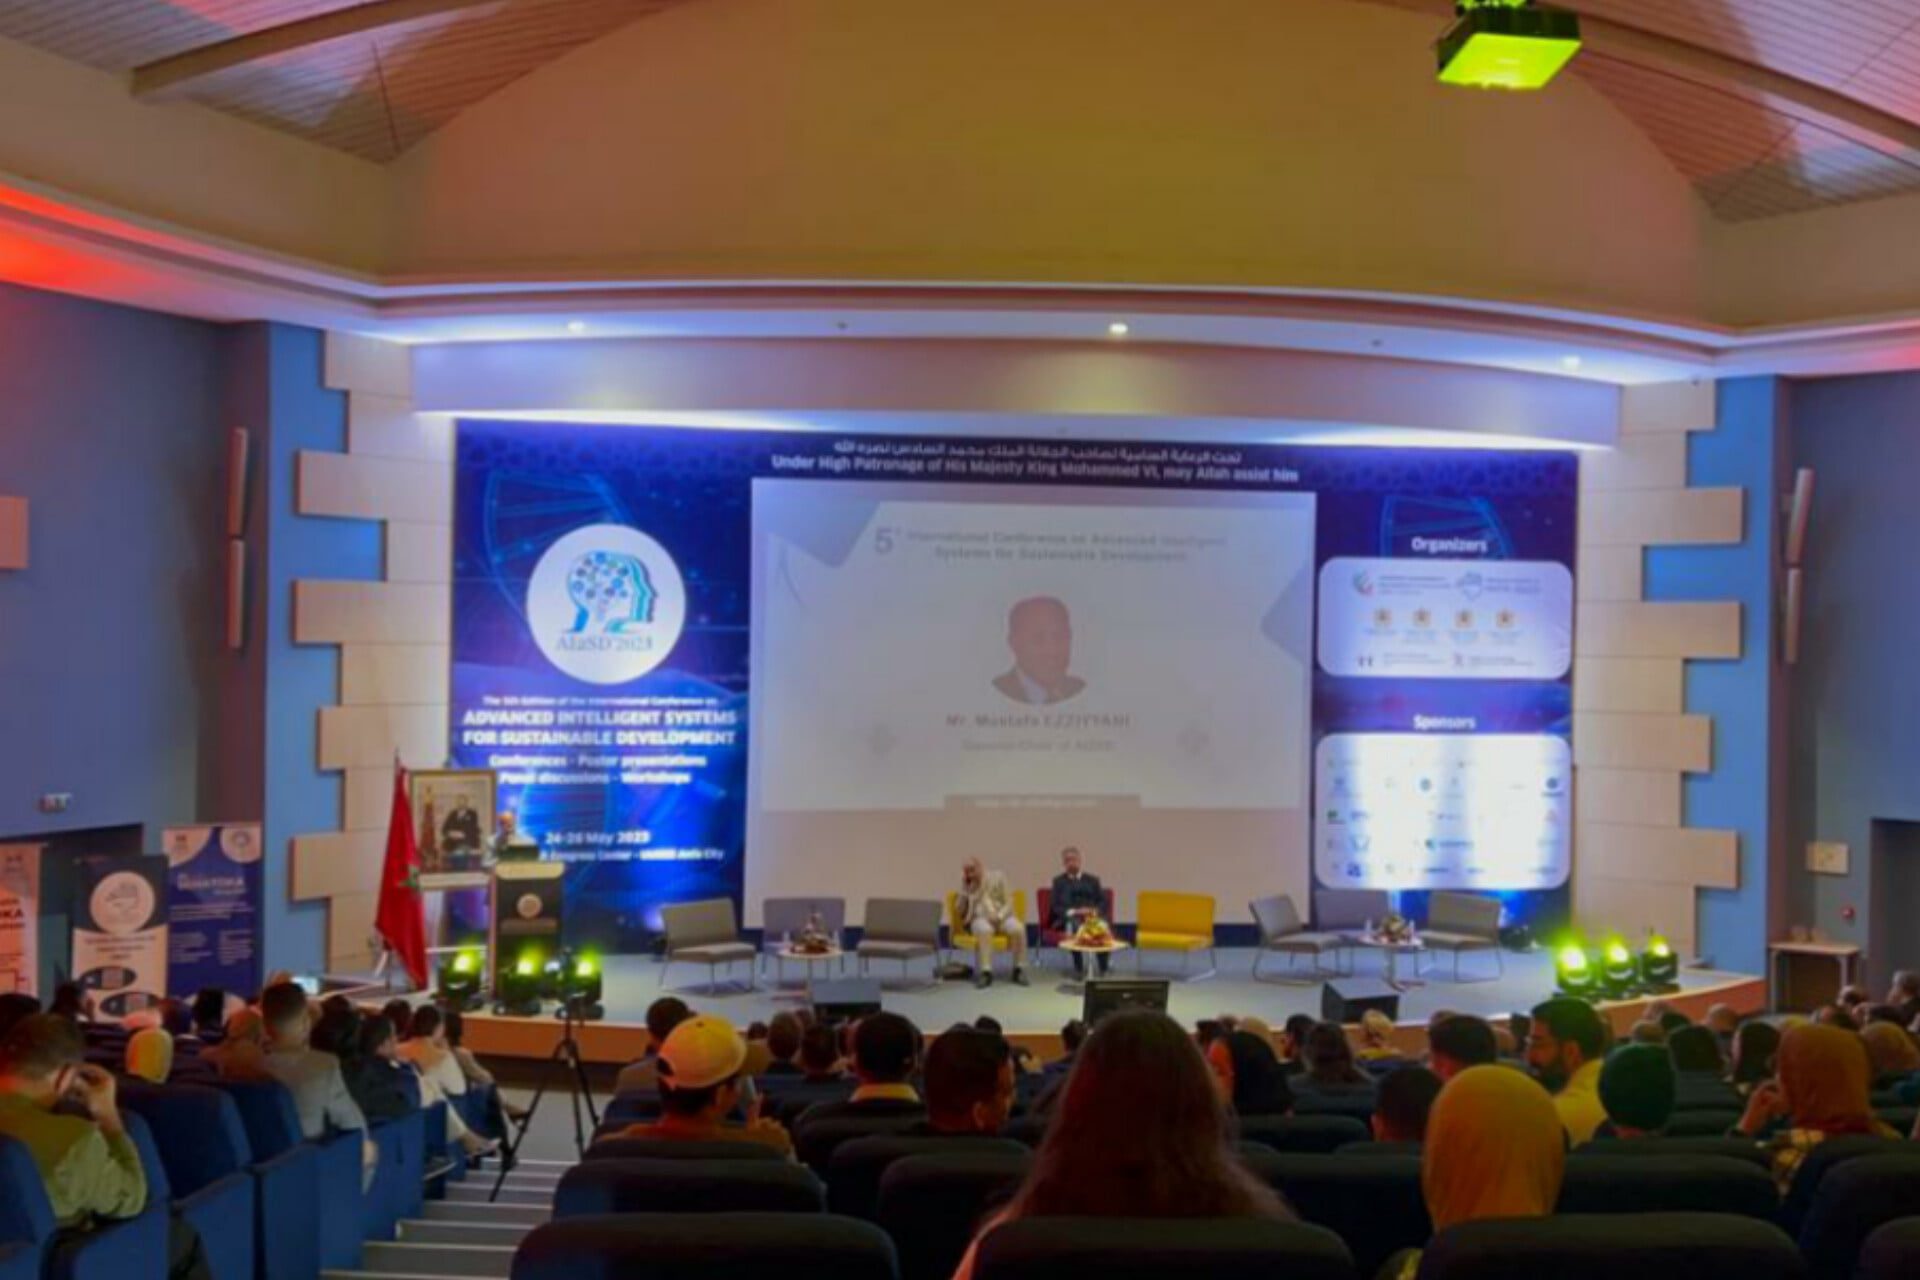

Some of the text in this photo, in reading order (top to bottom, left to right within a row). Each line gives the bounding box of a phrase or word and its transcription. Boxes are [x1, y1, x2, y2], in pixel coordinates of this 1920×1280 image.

[771, 454, 815, 470] Under
[818, 455, 850, 473] High
[853, 456, 924, 474] Patronage
[927, 457, 942, 473] of
[945, 459, 967, 473] His
[970, 459, 1024, 477] Majesty
[1027, 460, 1058, 478] King
[1196, 466, 1231, 480] Allah
[1411, 537, 1488, 553] Organizers
[463, 709, 737, 726] ADVANCED INTELLIGENT SYSTEMS
[1413, 714, 1476, 730] Sponsors
[463, 730, 735, 745] FOR SUSTAINABLE DEVELOPMENT
